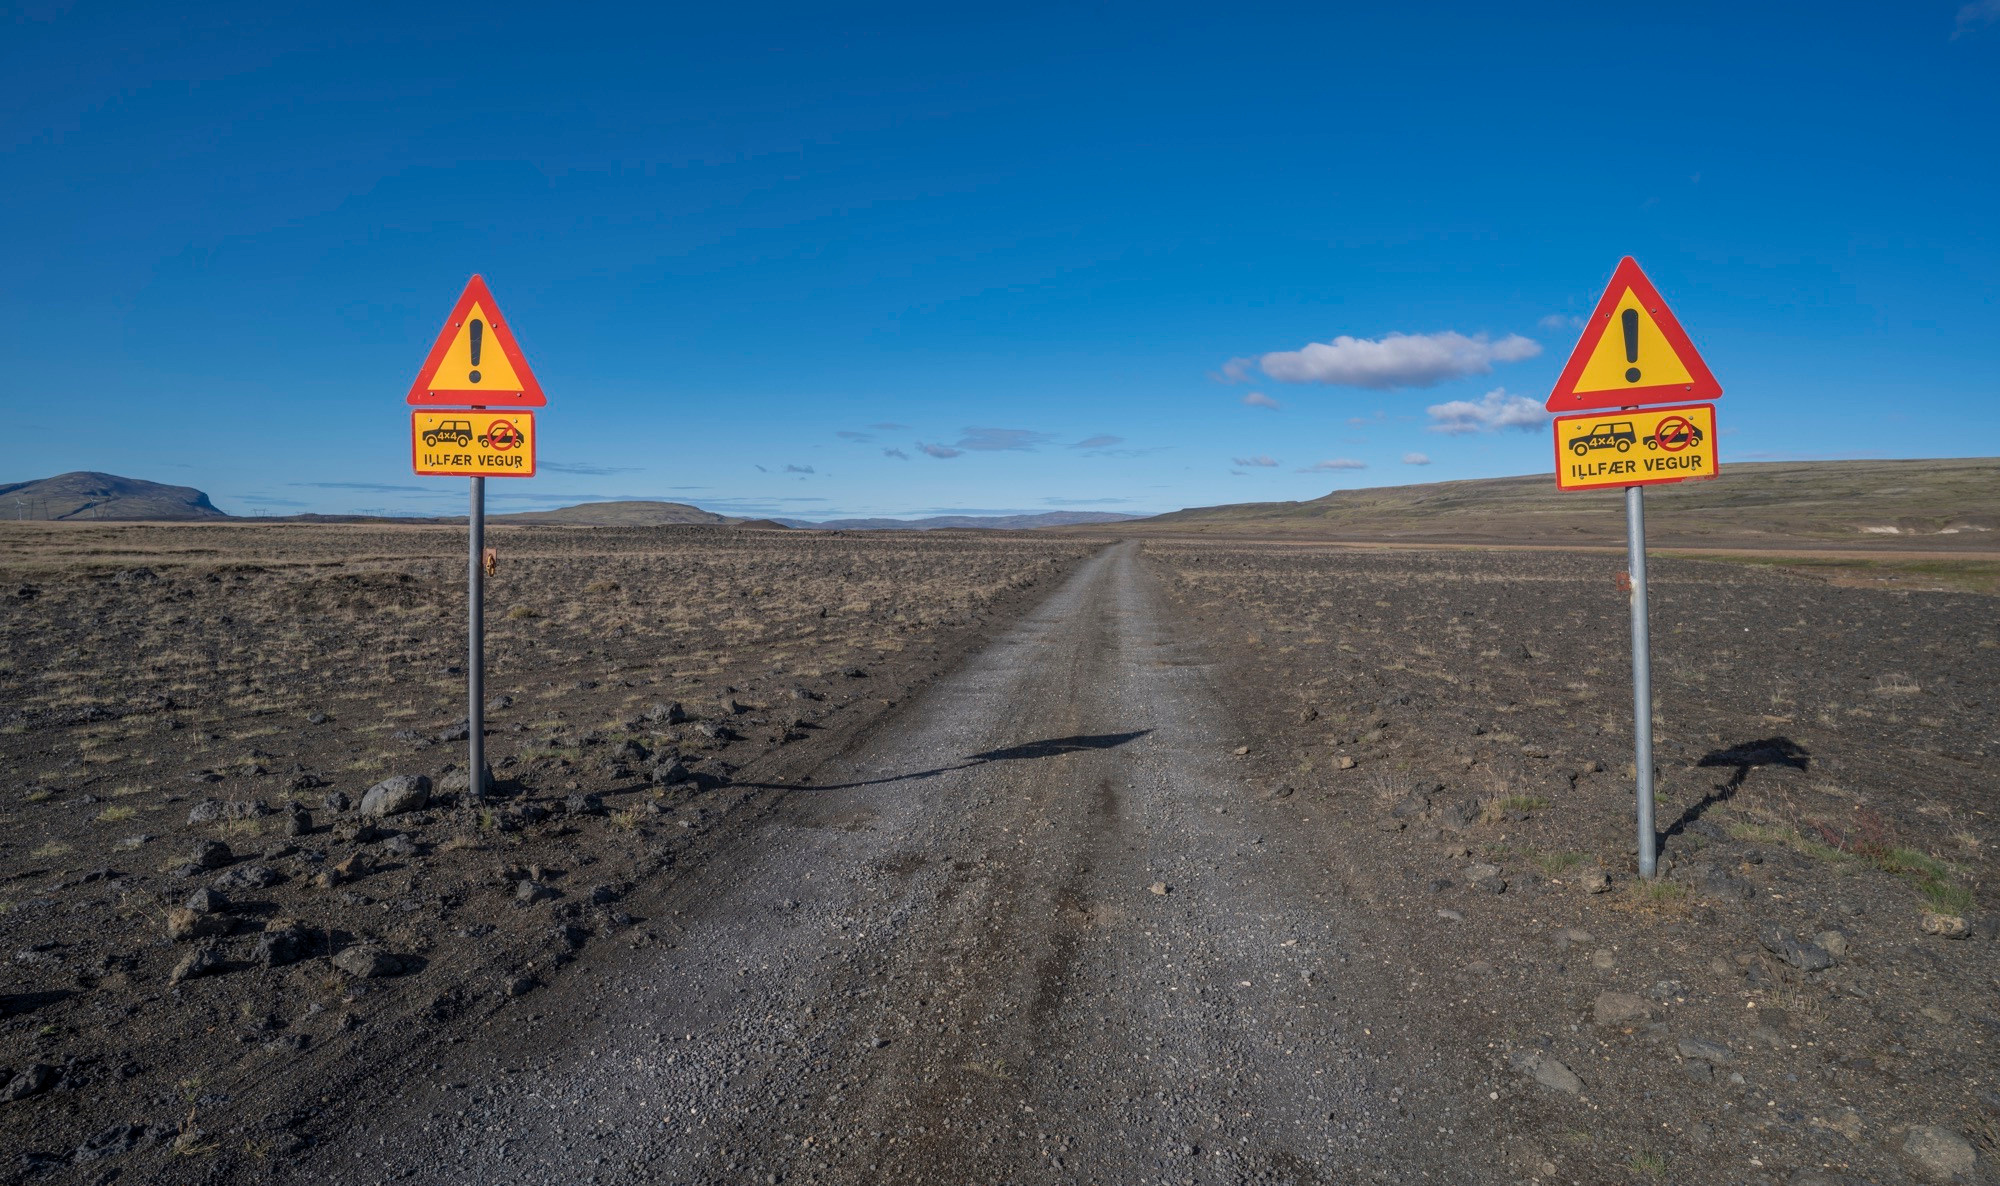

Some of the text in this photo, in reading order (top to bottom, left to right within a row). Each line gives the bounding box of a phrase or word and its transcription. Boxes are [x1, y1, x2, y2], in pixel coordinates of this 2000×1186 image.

[424, 454, 523, 467] ILLFÆR VEGUR
[1572, 455, 1702, 477] ILLFÆR VEGUR
